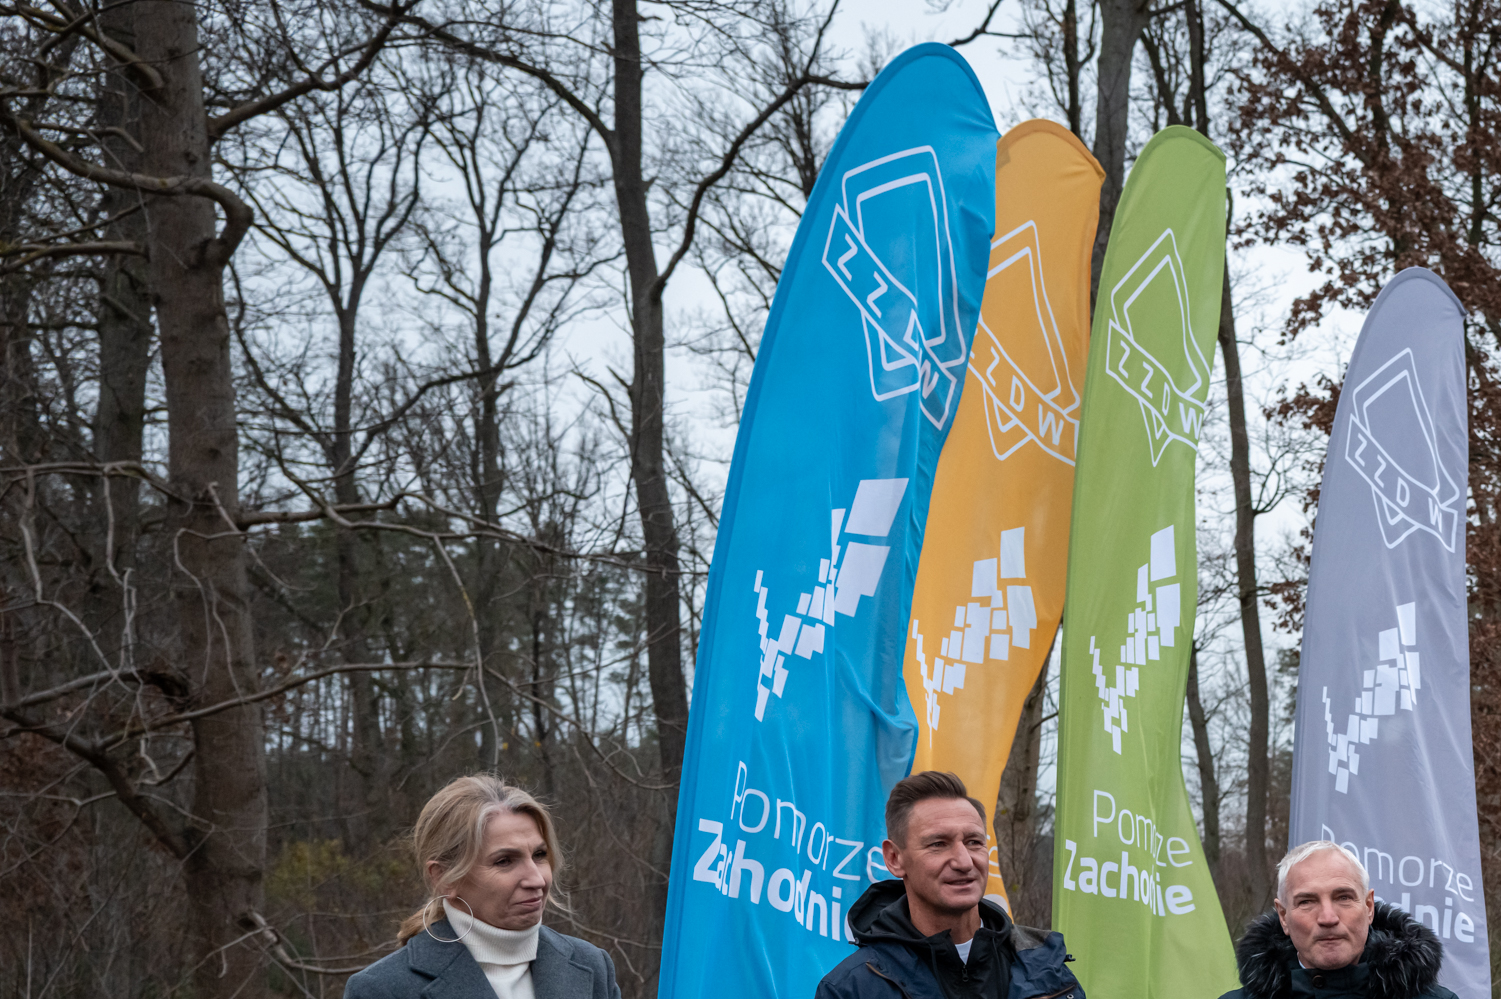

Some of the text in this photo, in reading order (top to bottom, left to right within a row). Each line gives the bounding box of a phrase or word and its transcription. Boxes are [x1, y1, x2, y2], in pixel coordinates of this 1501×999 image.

[970, 327, 1064, 446] ZDW
[1119, 340, 1203, 440] ZZDW
[1355, 433, 1442, 533] ZZDW
[693, 818, 856, 942] Zachodni
